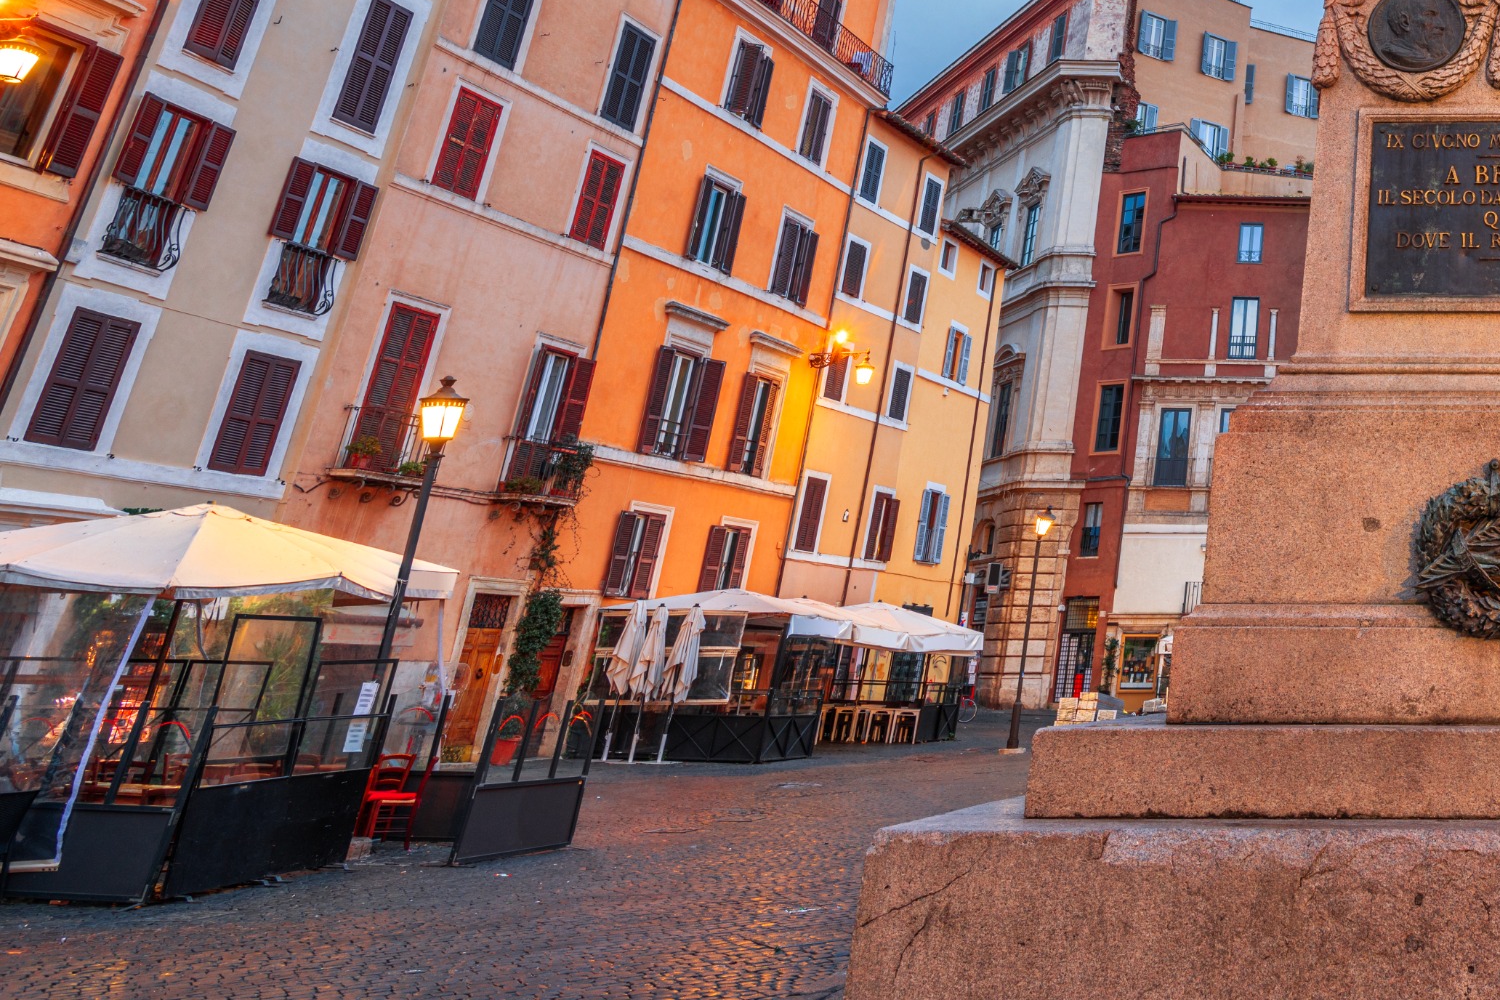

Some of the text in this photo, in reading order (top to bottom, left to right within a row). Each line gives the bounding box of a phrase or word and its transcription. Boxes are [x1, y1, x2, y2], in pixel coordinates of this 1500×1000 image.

[1387, 133, 1404, 149] IX
[1412, 133, 1480, 149] GIVGNO
[1445, 165, 1460, 185] A
[1377, 190, 1396, 205] IL
[1400, 190, 1475, 205] SECOLO
[1396, 232, 1450, 249] DOVE
[1461, 232, 1480, 249] IL
